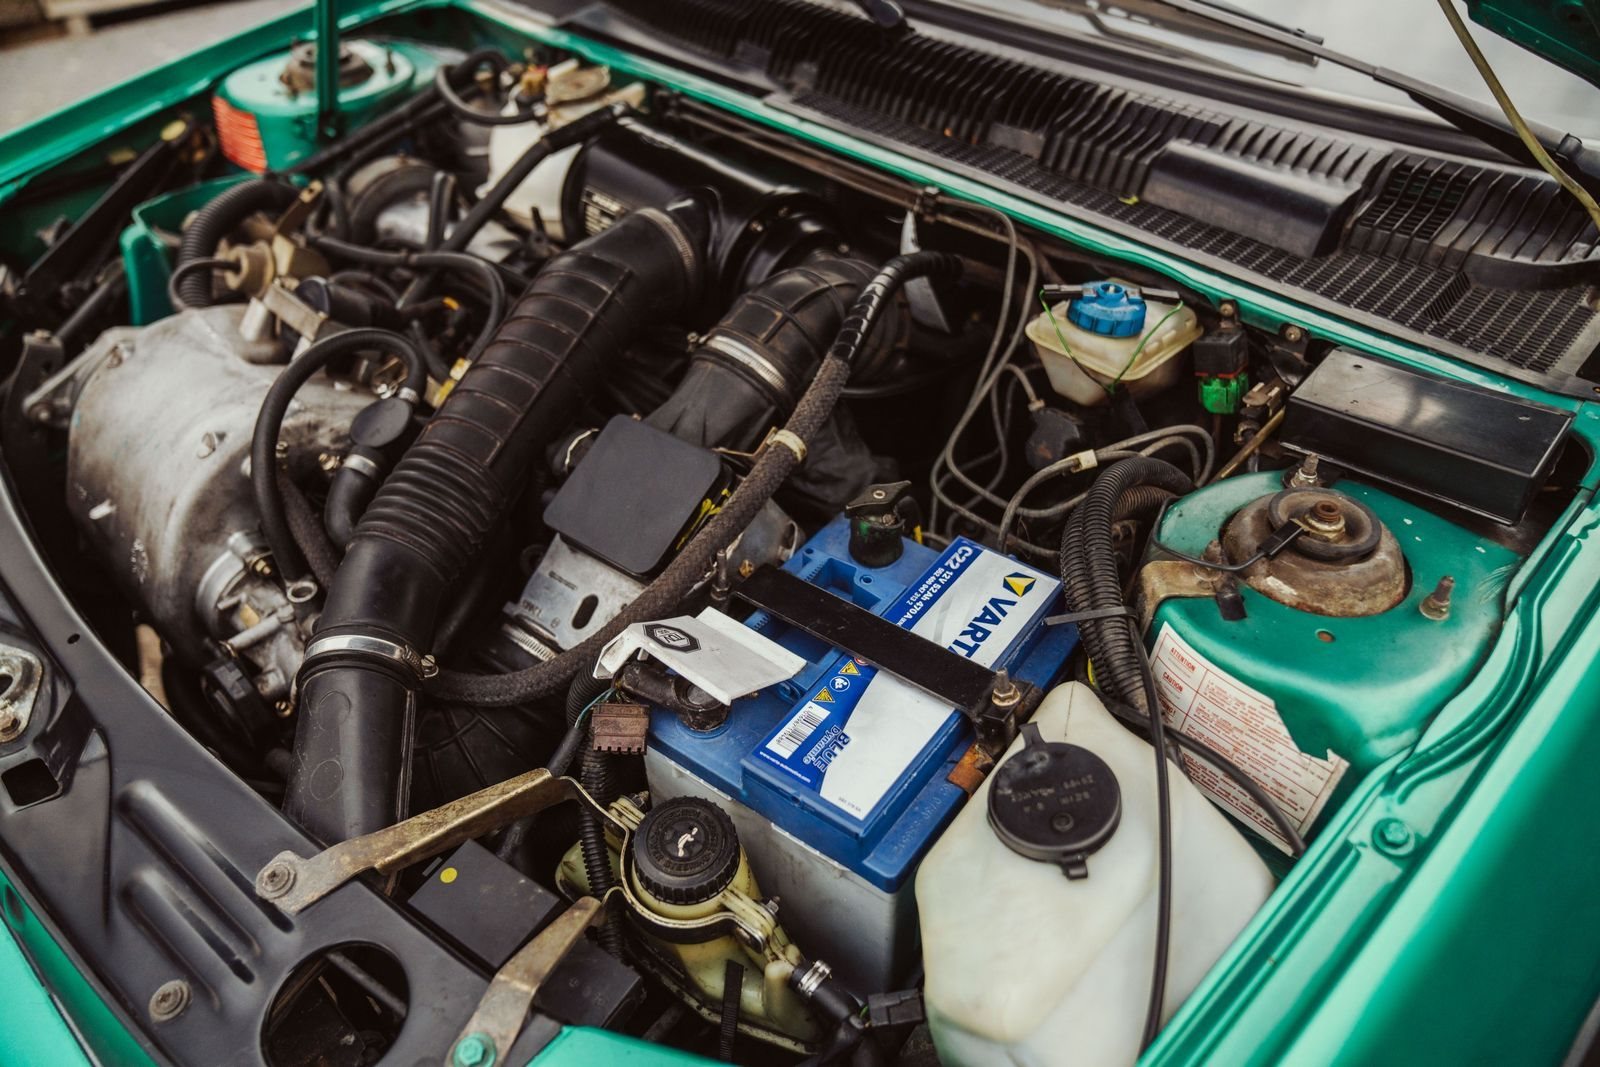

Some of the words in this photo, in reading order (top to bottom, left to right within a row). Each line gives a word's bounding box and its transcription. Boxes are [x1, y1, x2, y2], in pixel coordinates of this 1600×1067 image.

[944, 546, 973, 570] C22
[938, 571, 954, 585] 12V
[921, 583, 942, 601] 52Ah
[947, 597, 1018, 659] VART
[1171, 647, 1196, 672] ATTENTION
[1163, 671, 1183, 692] CAUTION
[802, 724, 842, 765] Dynamic
[813, 731, 851, 773] BLUE
